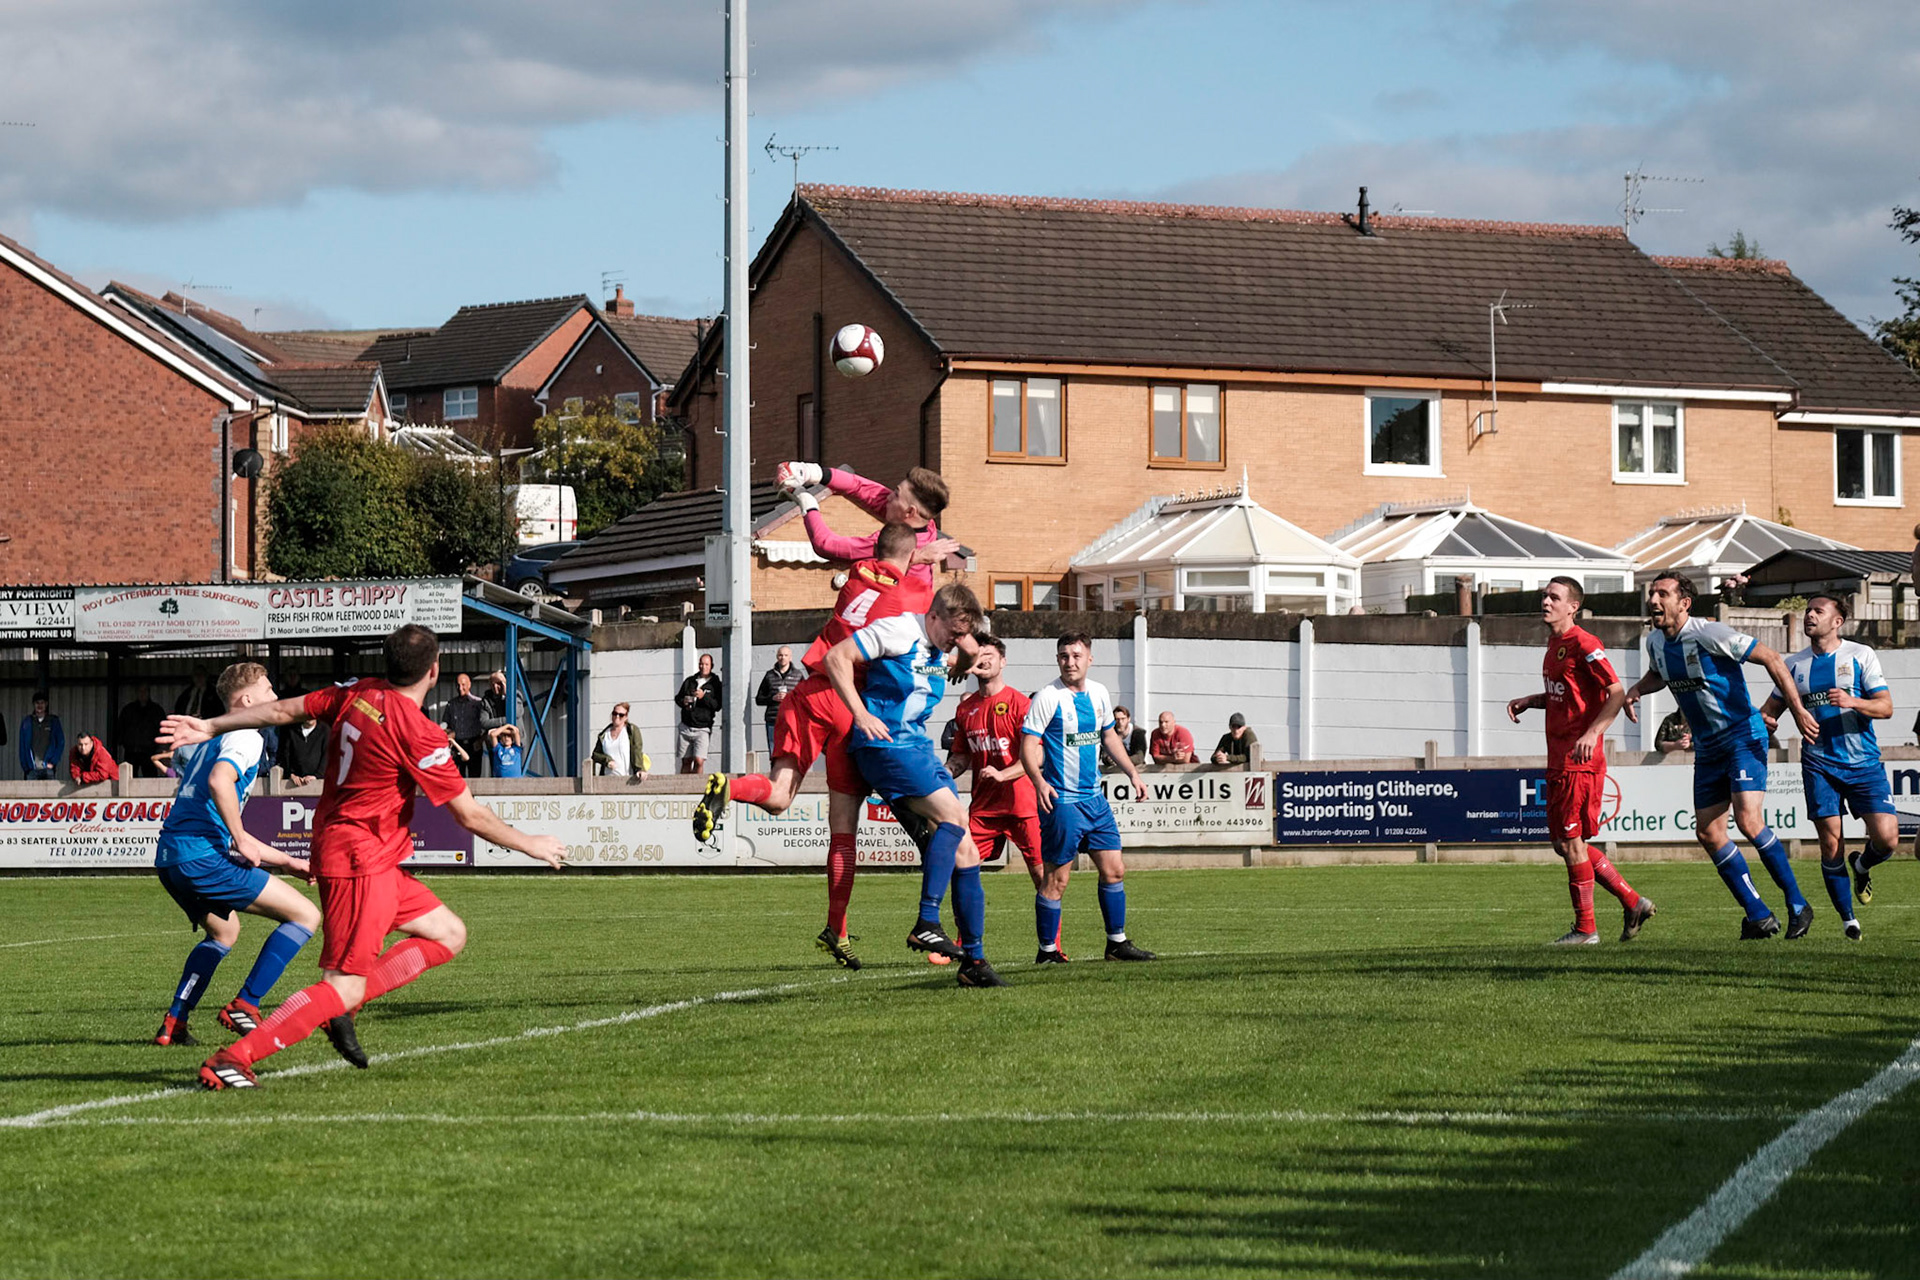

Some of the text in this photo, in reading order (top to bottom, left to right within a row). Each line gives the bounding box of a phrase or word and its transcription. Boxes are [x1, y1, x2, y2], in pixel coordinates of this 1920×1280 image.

[16, 589, 73, 599] FORTNIGHT?
[268, 585, 407, 609] CASTLE CHIPPY
[82, 588, 260, 612] ROY CATTERMOLE TREE SURGEONS
[9, 602, 69, 616] VIEW
[841, 588, 881, 627] 4
[36, 616, 71, 625] 422441
[268, 609, 405, 623] FRESH FISH FROM FLEETWOOD DAILY
[30, 630, 58, 639] PHONE
[60, 629, 72, 638] US
[312, 625, 338, 633] Clitheroe
[967, 734, 1010, 753] Milne
[336, 720, 362, 786] 5
[1282, 780, 1459, 801] Supporting Clitheroe,
[567, 802, 595, 821] the
[601, 800, 731, 820] BUTCHES
[1153, 804, 1187, 814] wine
[1194, 803, 1218, 814] bar
[1282, 801, 1413, 821] Supporting You.
[1130, 820, 1153, 829] King
[1157, 820, 1170, 828] St,
[1174, 819, 1222, 828] Clitheroe
[1226, 818, 1264, 827] 443906
[1597, 809, 1666, 831] Archer
[1764, 806, 1797, 829] Ltd
[69, 823, 126, 834] Clitheroe
[757, 827, 812, 836] SUPPLIERS
[815, 827, 828, 836] OF
[1283, 827, 1428, 837] www.harrison-drury.com 01200 422264
[1501, 826, 1522, 834] make
[1522, 826, 1528, 834] it
[277, 832, 303, 840] Amazing
[587, 826, 620, 843] Tel:
[7, 837, 18, 845] 83
[21, 837, 58, 845] SEATER
[60, 837, 99, 845] LUXURY
[288, 840, 311, 848] delivery
[857, 839, 891, 848] RAVEL,
[49, 847, 147, 857] TEL 01200 429220
[598, 844, 629, 861] 423
[632, 844, 664, 861] 450
[869, 850, 915, 862] 423189
